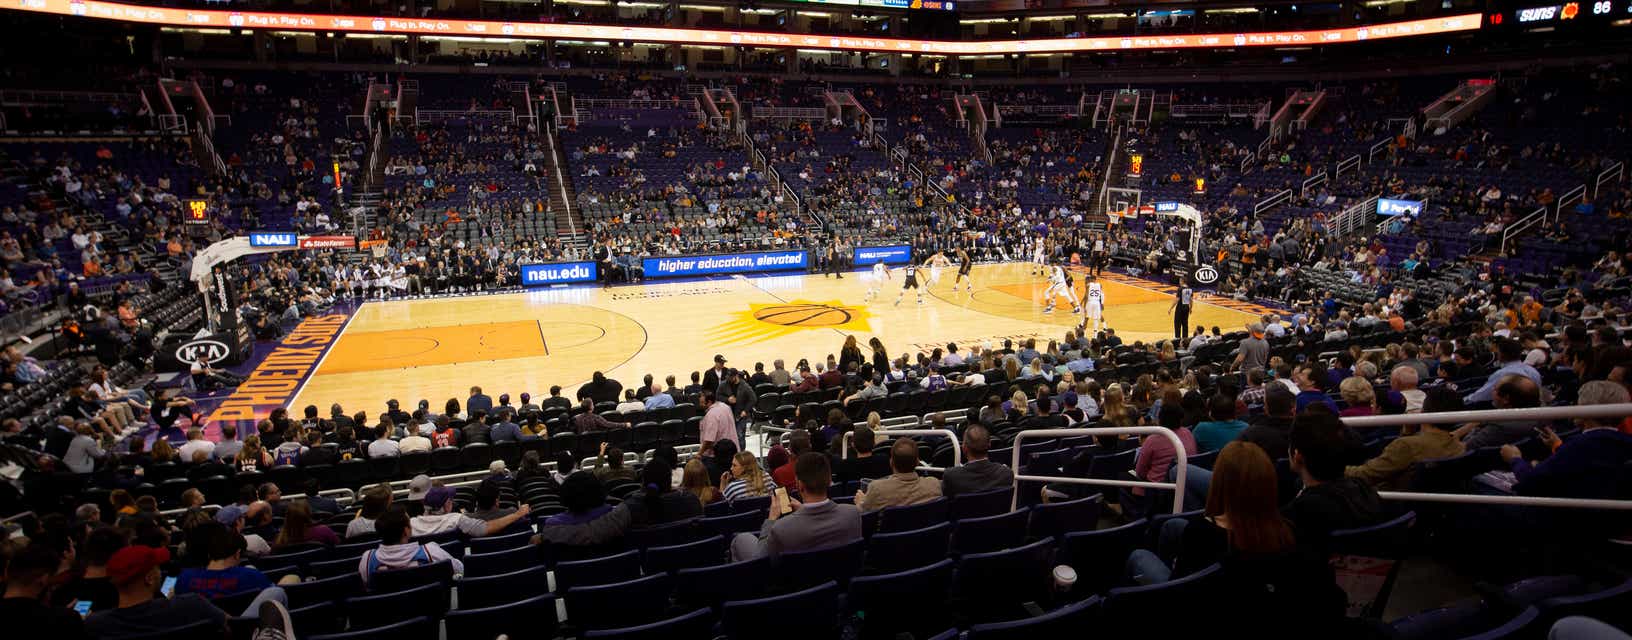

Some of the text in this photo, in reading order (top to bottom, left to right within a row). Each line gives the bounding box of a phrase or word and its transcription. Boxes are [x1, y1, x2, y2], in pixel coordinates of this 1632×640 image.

[1593, 1, 1611, 14] 86
[249, 16, 267, 25] Plug
[280, 17, 298, 27] Play
[390, 20, 407, 29] Plug
[419, 21, 435, 31] Play
[1249, 35, 1265, 44] Plug
[1276, 34, 1291, 43] Play
[256, 235, 290, 245] NAU
[658, 252, 802, 273] higher education, elevated
[528, 265, 589, 281] nau.edu
[1199, 270, 1215, 280] KIA
[1090, 289, 1099, 297] 25
[205, 345, 327, 422] PHOENIX
